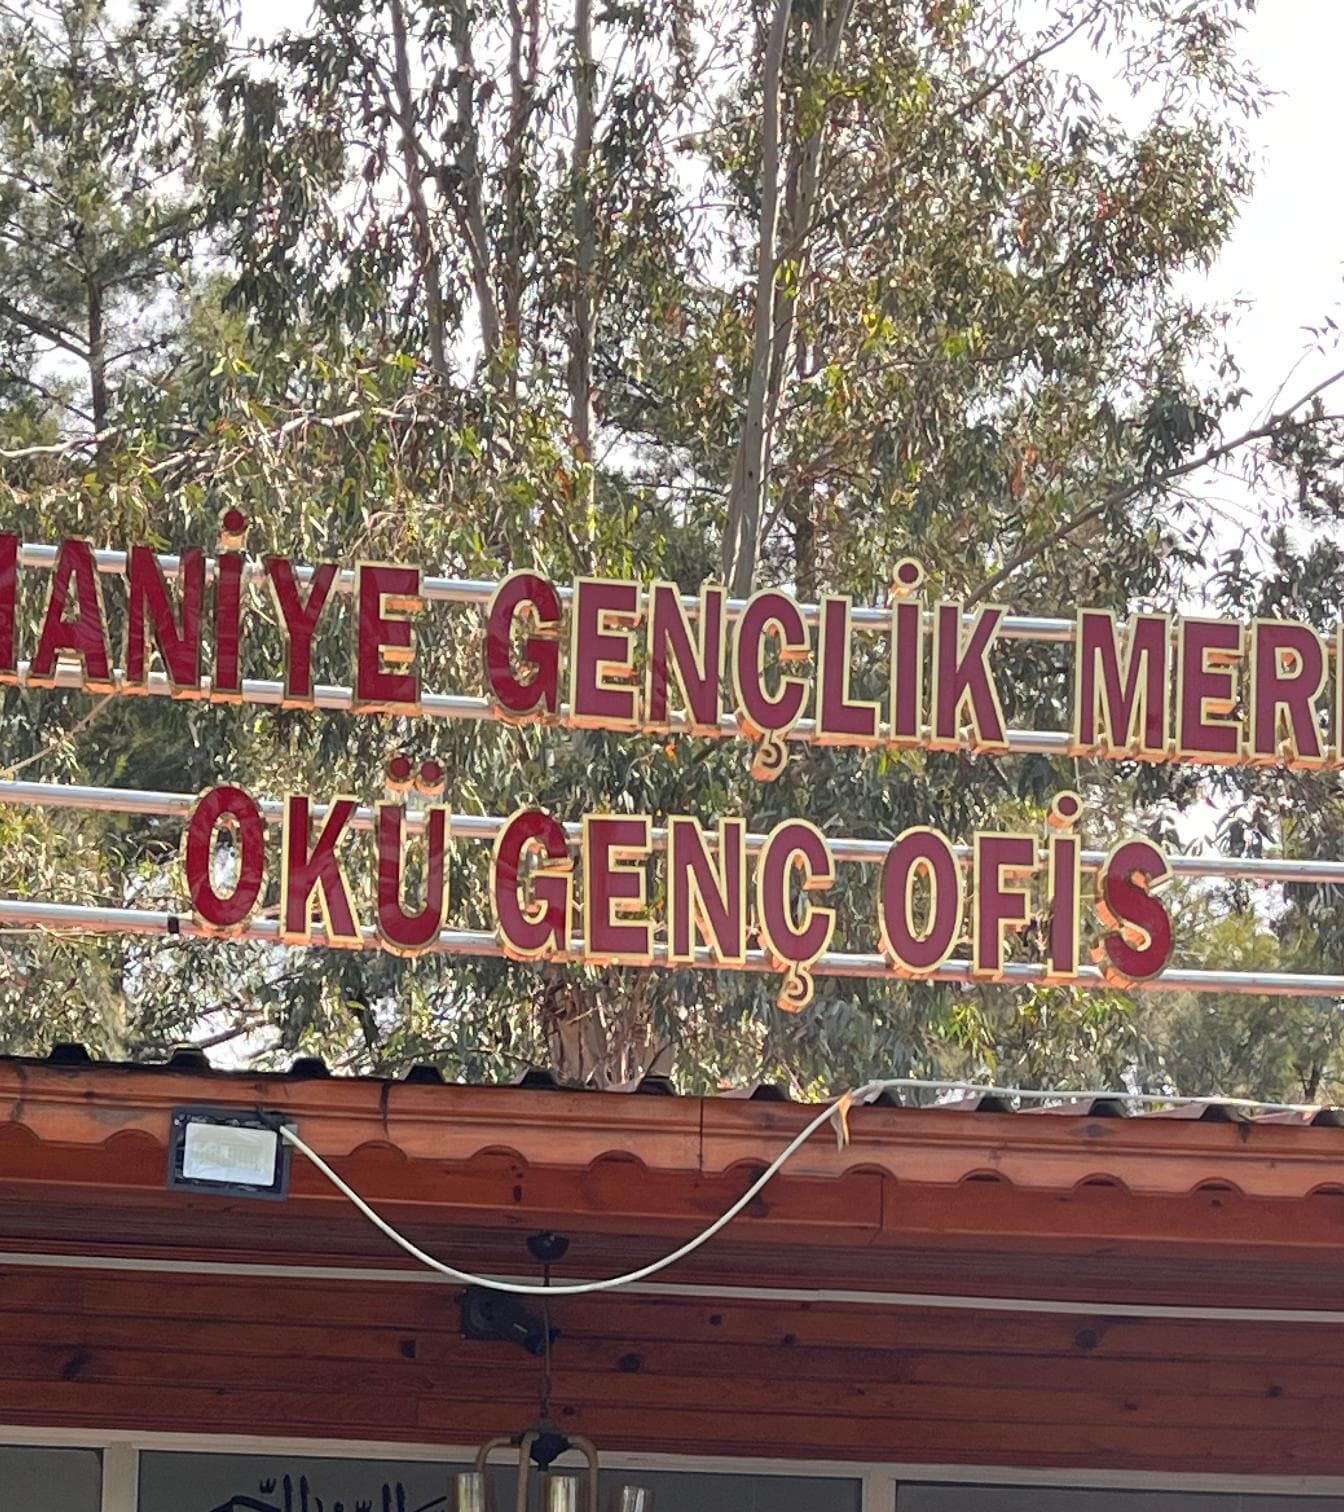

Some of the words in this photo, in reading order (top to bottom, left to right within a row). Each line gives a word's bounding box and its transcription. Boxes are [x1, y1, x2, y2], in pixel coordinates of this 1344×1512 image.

[485, 557, 1010, 780] GENÇLİK
[185, 756, 452, 956] OKÜ
[490, 805, 837, 1013] GENÇ
[879, 790, 1174, 987] OFİS
